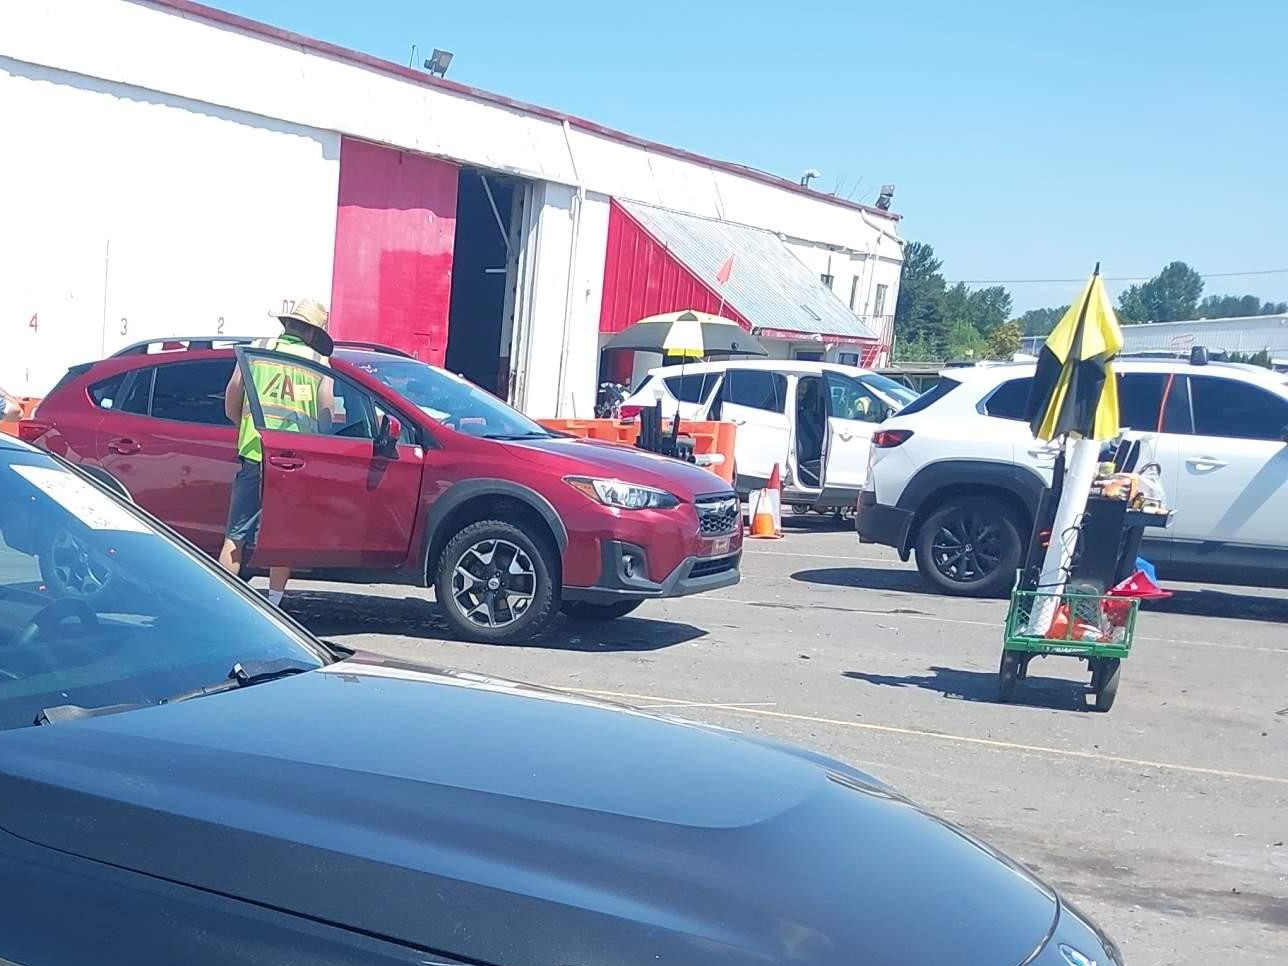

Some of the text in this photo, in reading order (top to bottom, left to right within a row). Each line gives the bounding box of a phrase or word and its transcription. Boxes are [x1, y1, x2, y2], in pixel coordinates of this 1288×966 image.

[29, 312, 38, 333] 4
[119, 317, 128, 336] 3
[217, 316, 225, 335] 2
